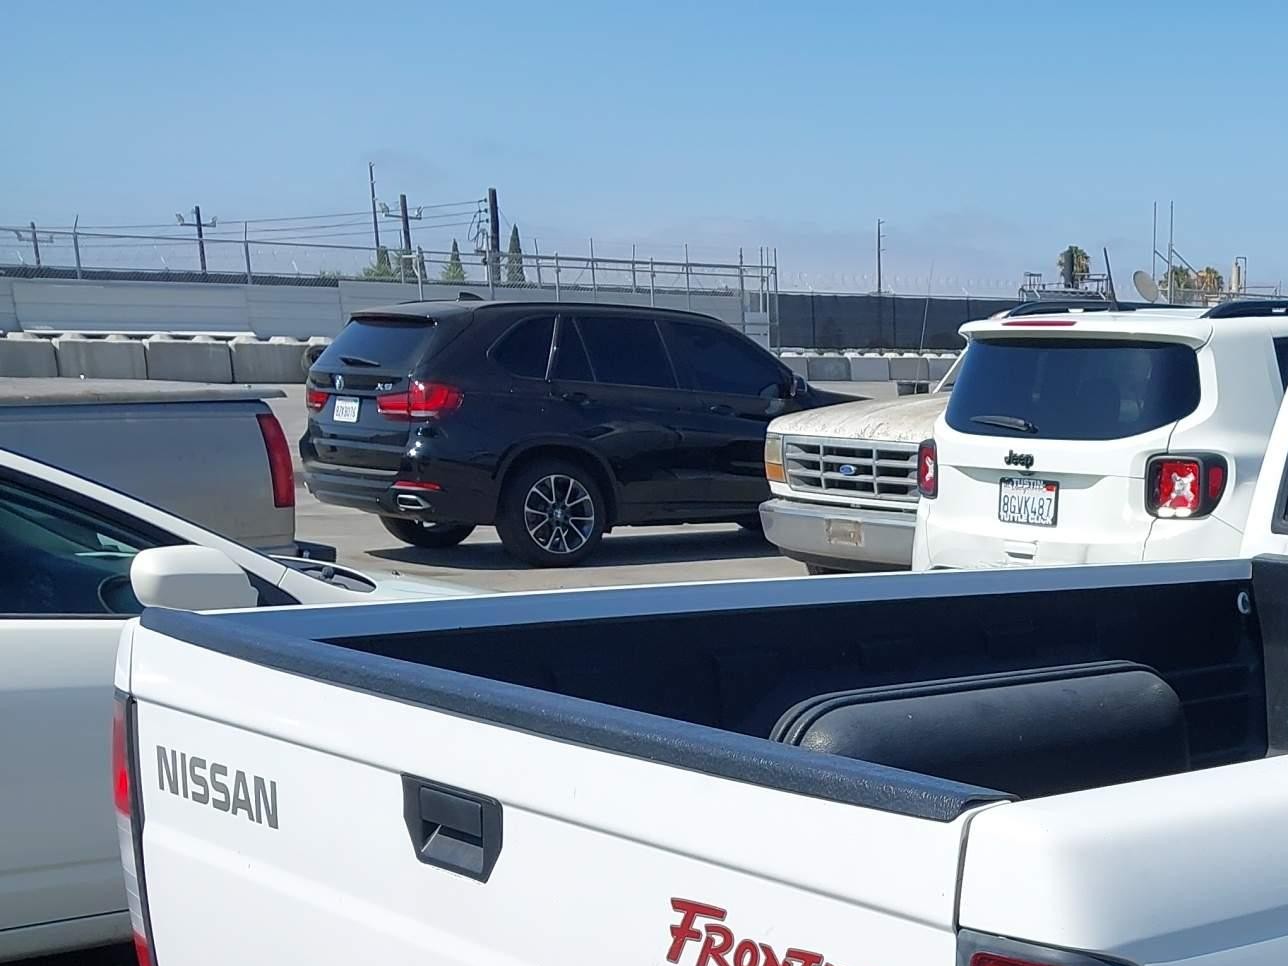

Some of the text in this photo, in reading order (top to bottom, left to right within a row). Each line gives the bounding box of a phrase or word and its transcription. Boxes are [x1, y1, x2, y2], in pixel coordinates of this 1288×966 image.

[1004, 449, 1034, 469] Jeep
[1002, 494, 1053, 517] 8GVK487
[156, 745, 279, 830] NISSAN
